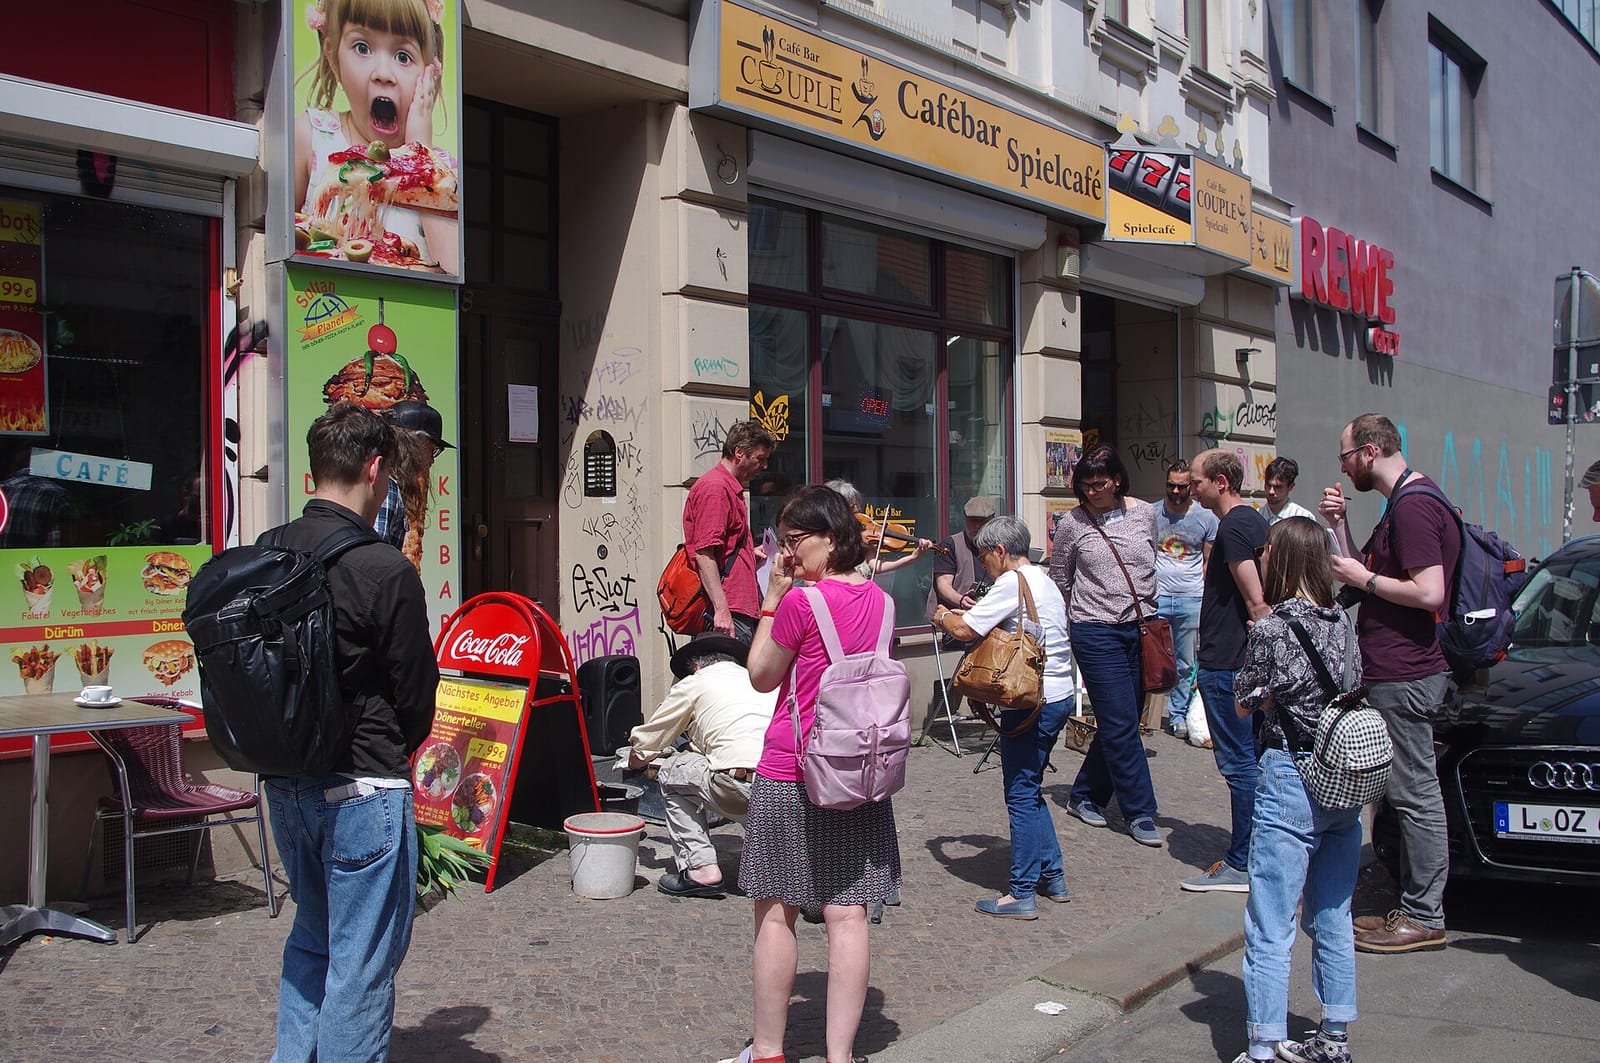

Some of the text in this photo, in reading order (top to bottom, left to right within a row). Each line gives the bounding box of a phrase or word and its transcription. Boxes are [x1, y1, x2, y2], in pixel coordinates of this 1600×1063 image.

[779, 37, 820, 63] Café Bar
[898, 80, 1102, 201] Cafébar Spielcafé
[1197, 189, 1237, 220] COUPLE
[1123, 223, 1176, 235] Spielcafé
[1302, 215, 1397, 325] REWE
[296, 280, 336, 308] Sultan
[862, 397, 888, 416] OPEN
[57, 454, 129, 485] CAFÉ
[890, 507, 902, 517] Bar
[21, 611, 51, 620] Falafel
[61, 608, 116, 618] Vegetarisches
[44, 626, 84, 640] Dürüm
[152, 621, 185, 633] Döner
[450, 629, 531, 666] Coca-Cola
[172, 688, 194, 697] Kebab
[438, 684, 480, 702] Nächstes
[483, 693, 521, 709] Angebot
[435, 710, 487, 729] Dönerteller
[1522, 807, 1587, 832] L OZ
